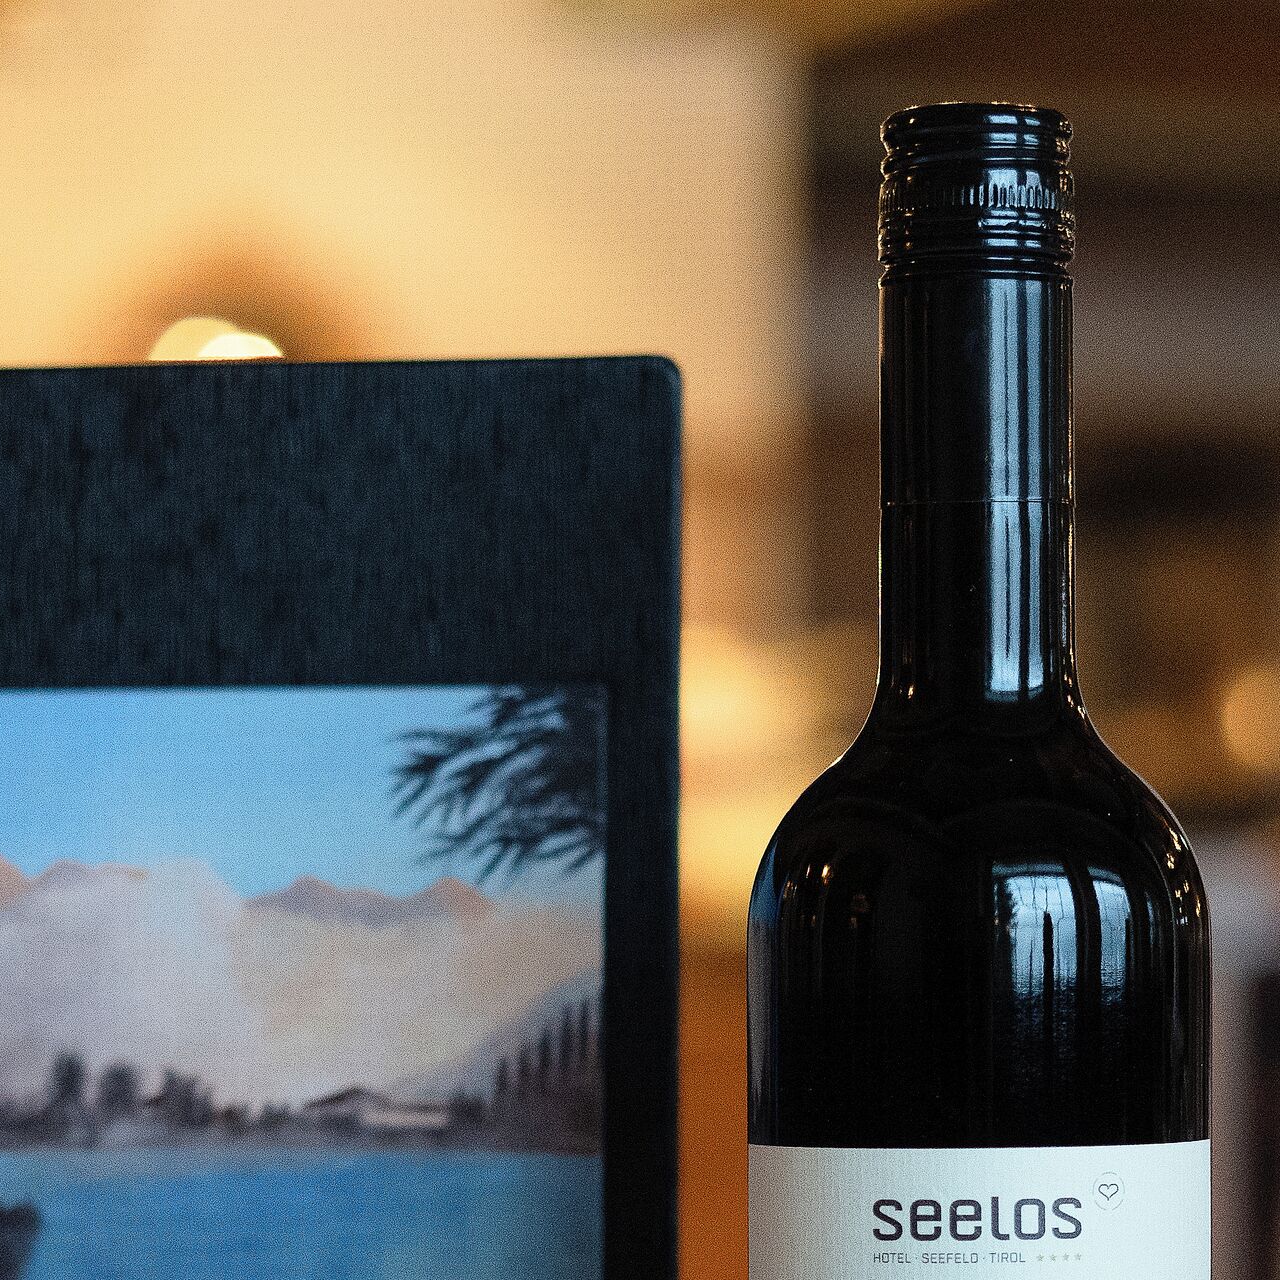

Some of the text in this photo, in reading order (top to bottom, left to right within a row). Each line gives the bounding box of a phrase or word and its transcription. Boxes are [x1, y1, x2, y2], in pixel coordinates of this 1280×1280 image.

[872, 1196, 1083, 1241] seelos
[873, 1251, 1026, 1264] HOTEL SEEFELD TIROL
